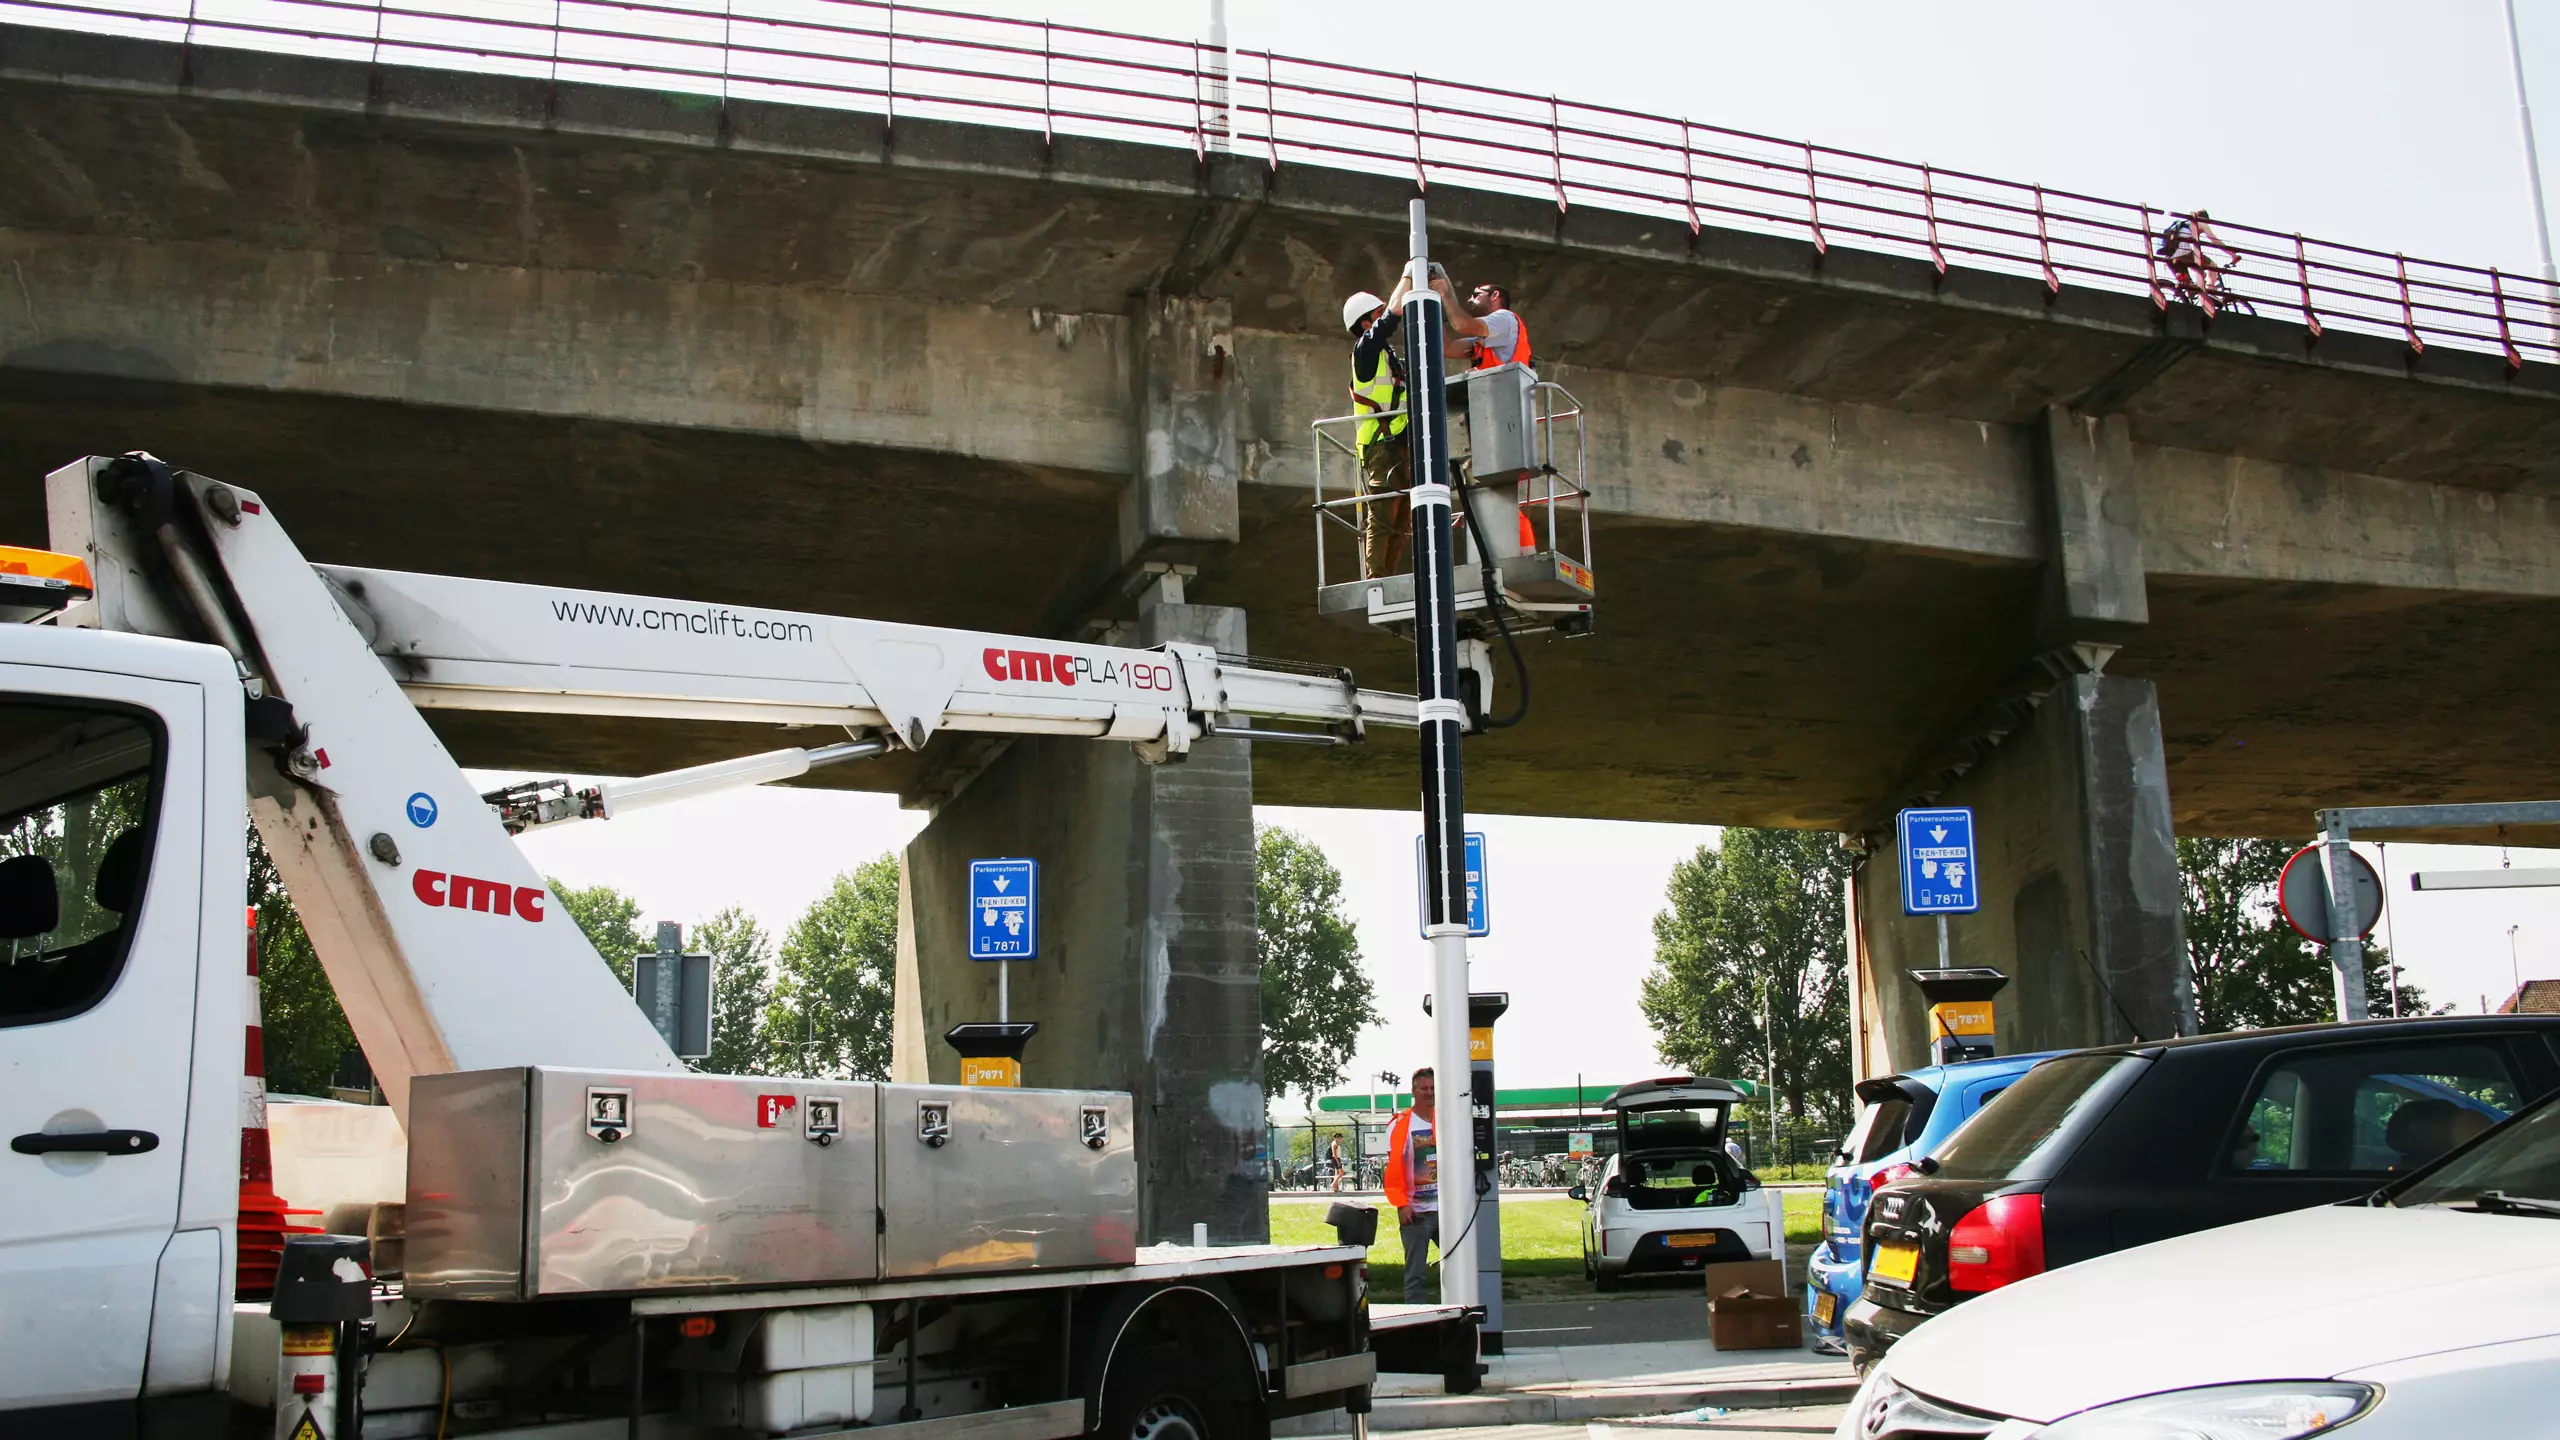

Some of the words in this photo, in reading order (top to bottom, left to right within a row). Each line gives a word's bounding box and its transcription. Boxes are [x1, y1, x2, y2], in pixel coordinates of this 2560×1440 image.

[551, 600, 813, 642] www.cmclift.com
[1935, 894, 1964, 904] 7871
[993, 941, 1020, 951] 7871
[1958, 1014, 1985, 1025] 7871
[979, 1070, 1003, 1080] 7871
